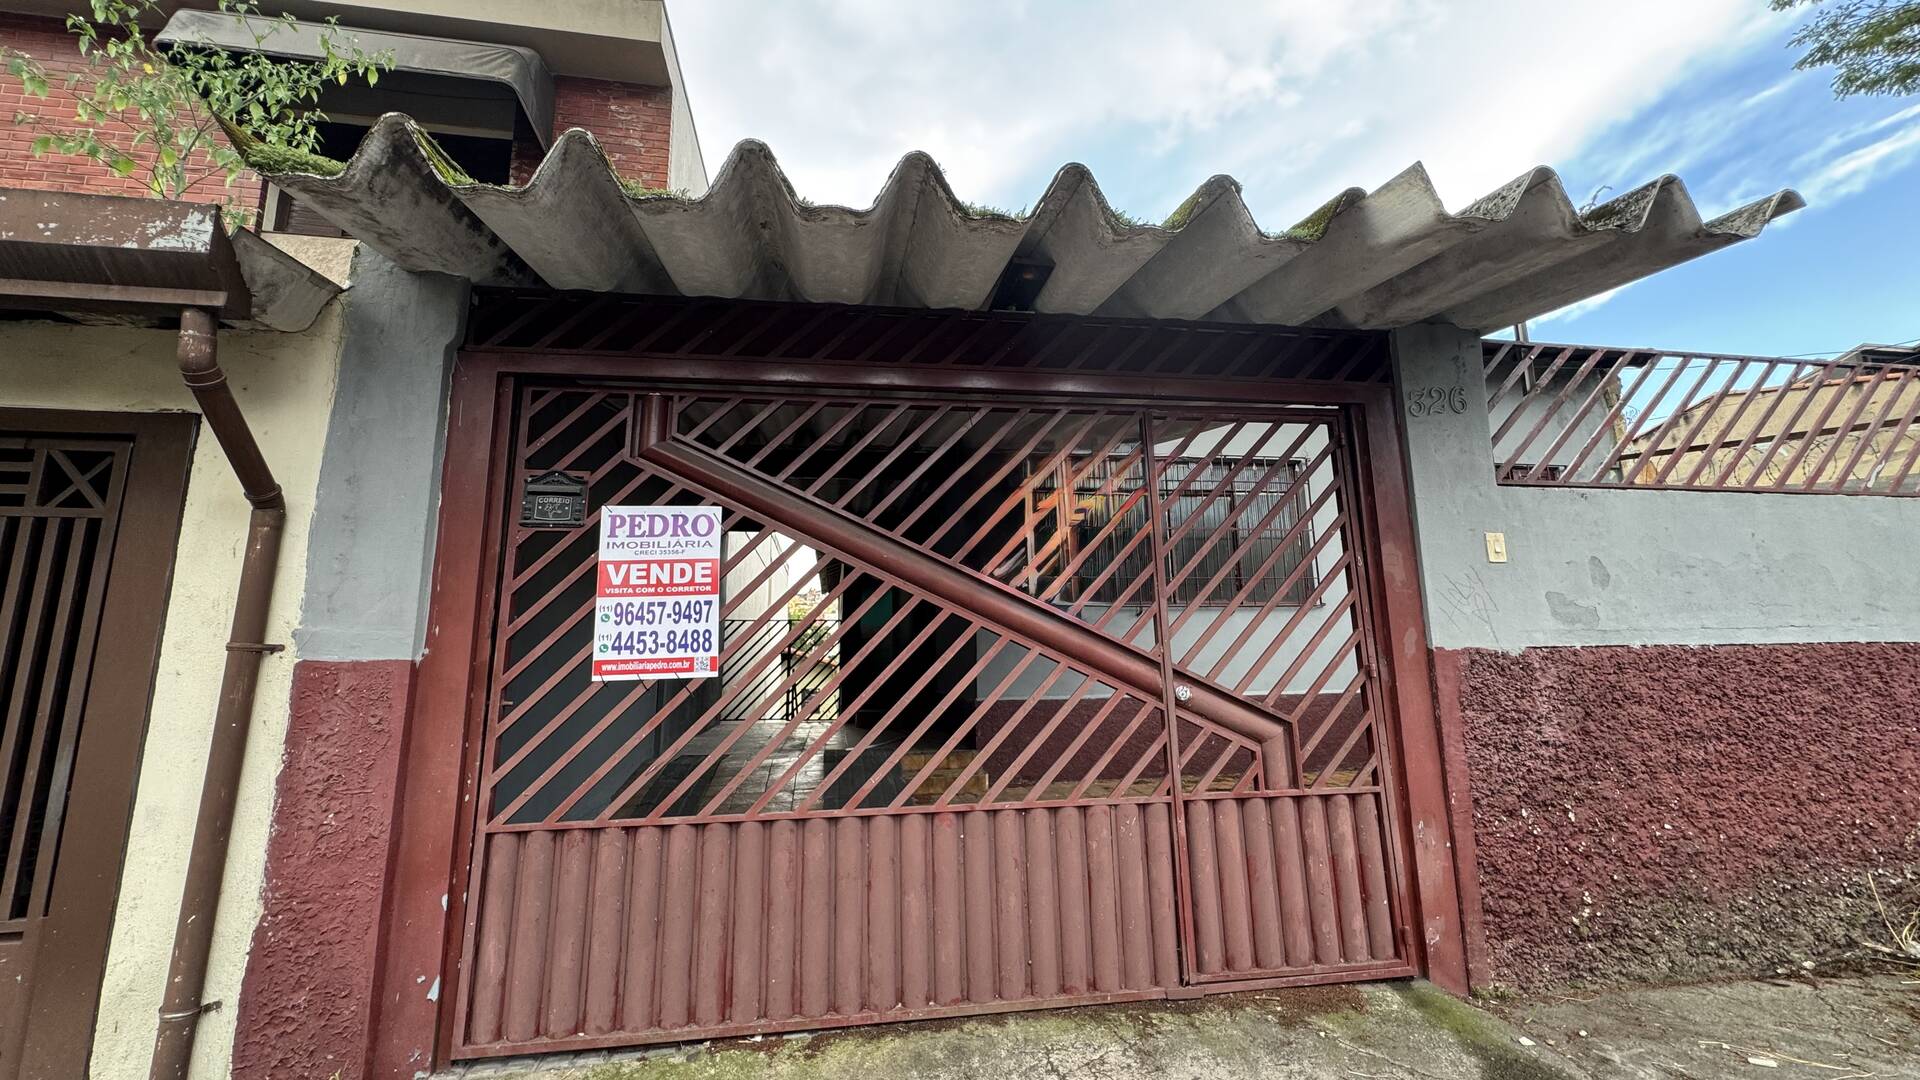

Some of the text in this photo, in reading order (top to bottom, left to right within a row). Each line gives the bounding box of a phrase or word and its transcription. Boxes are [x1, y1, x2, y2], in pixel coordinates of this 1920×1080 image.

[1408, 385, 1467, 417] 326
[538, 497, 570, 505] CORREIO
[607, 514, 715, 538] PEDRO
[606, 539, 713, 549] IMOBILIÁRIA
[606, 562, 712, 585] VENDE
[614, 600, 713, 626] 96457-9497
[611, 629, 712, 655] 4453-8488
[601, 660, 691, 671] www.imobiliariapedro.com.br
